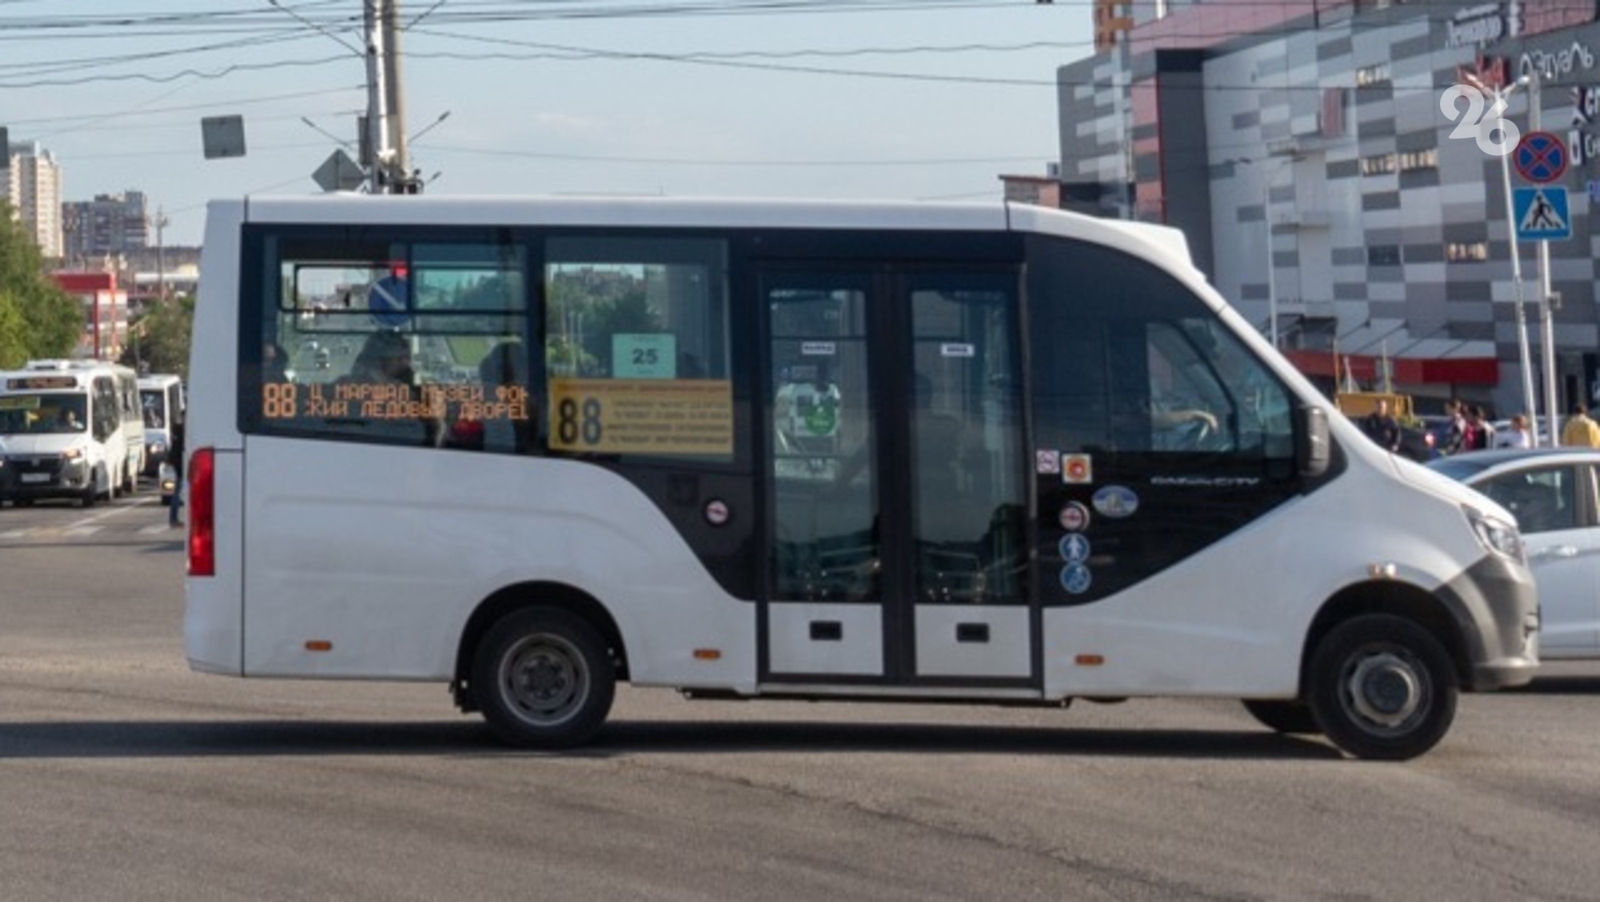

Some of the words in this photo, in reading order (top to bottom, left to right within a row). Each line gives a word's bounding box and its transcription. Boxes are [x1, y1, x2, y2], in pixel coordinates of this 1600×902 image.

[632, 348, 658, 365] 25
[263, 383, 297, 418] 88
[558, 397, 602, 445] 88
